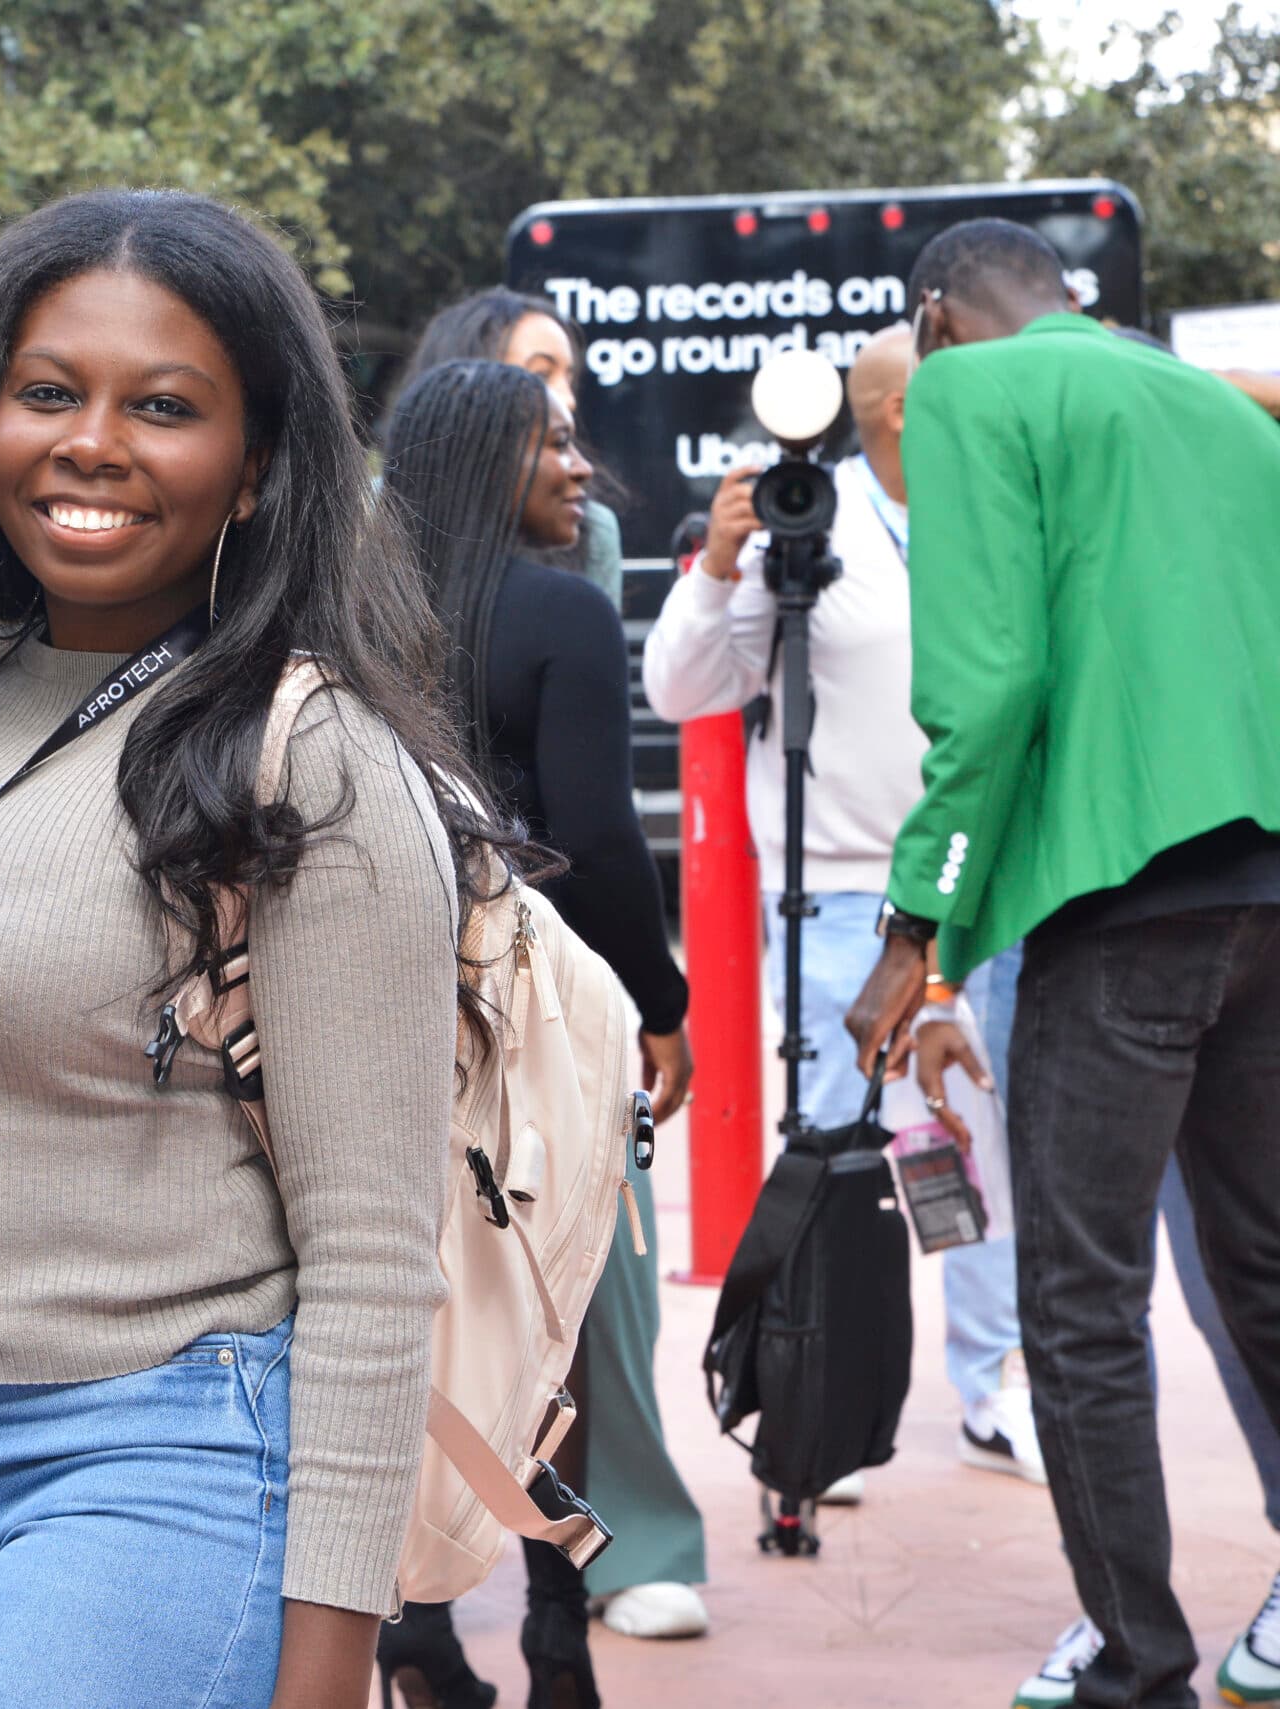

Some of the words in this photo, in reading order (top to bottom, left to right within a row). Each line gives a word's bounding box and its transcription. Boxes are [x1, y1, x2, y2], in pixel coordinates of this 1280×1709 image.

[545, 278, 640, 324] The
[646, 269, 833, 322] records
[837, 275, 906, 316] on
[586, 338, 657, 386] go
[815, 330, 872, 369] an
[78, 642, 173, 728] AFROTECH
